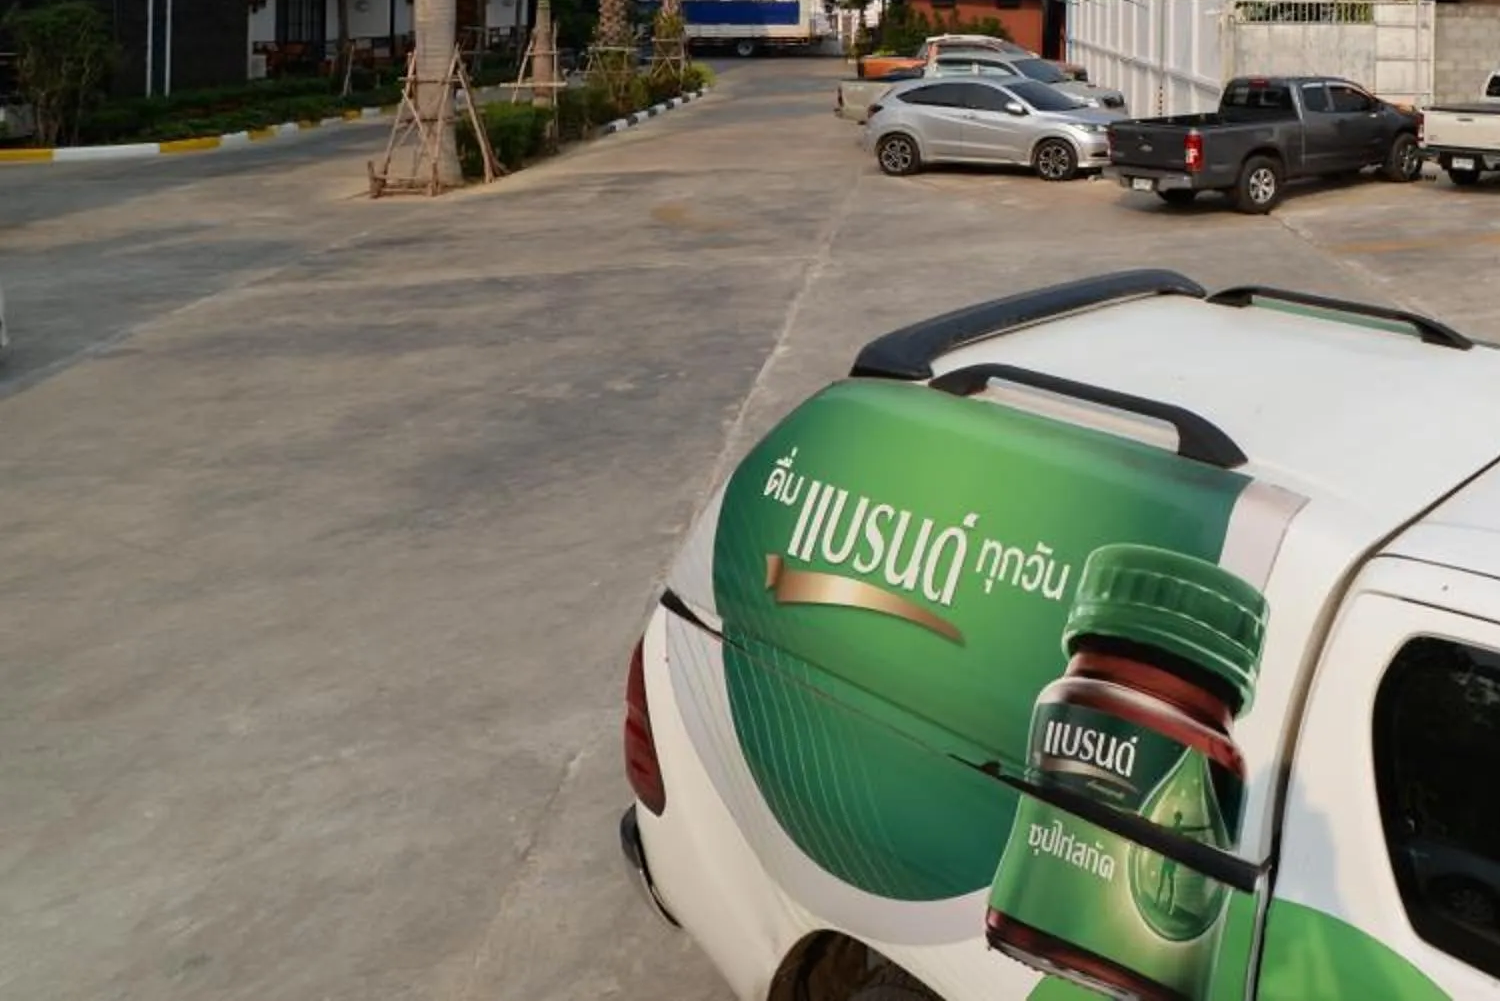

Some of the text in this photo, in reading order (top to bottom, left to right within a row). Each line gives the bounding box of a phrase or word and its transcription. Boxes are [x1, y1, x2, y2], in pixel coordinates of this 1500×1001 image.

[763, 446, 1071, 606] ดื่ม แบรนด์ ทุกวัน
[1043, 720, 1140, 778] แบรนด์
[1028, 819, 1116, 882] ซุปไก่สกัด
